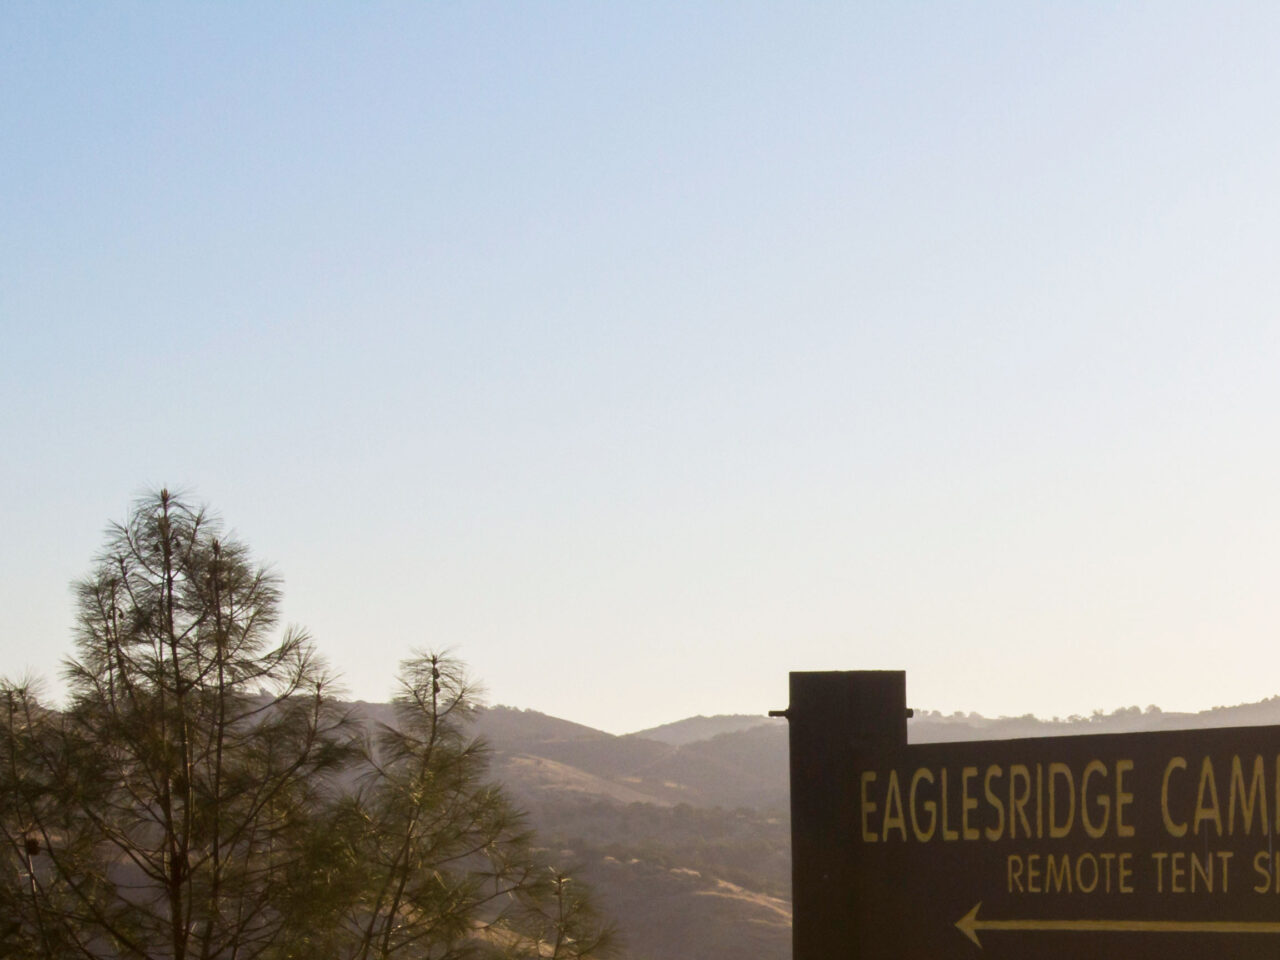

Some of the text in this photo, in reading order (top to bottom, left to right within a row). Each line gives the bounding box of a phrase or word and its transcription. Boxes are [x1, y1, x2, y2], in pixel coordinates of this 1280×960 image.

[861, 759, 1136, 843] EAGLESRIDGE
[1007, 852, 1134, 894] REMOTE
[1152, 851, 1234, 893] TENT
